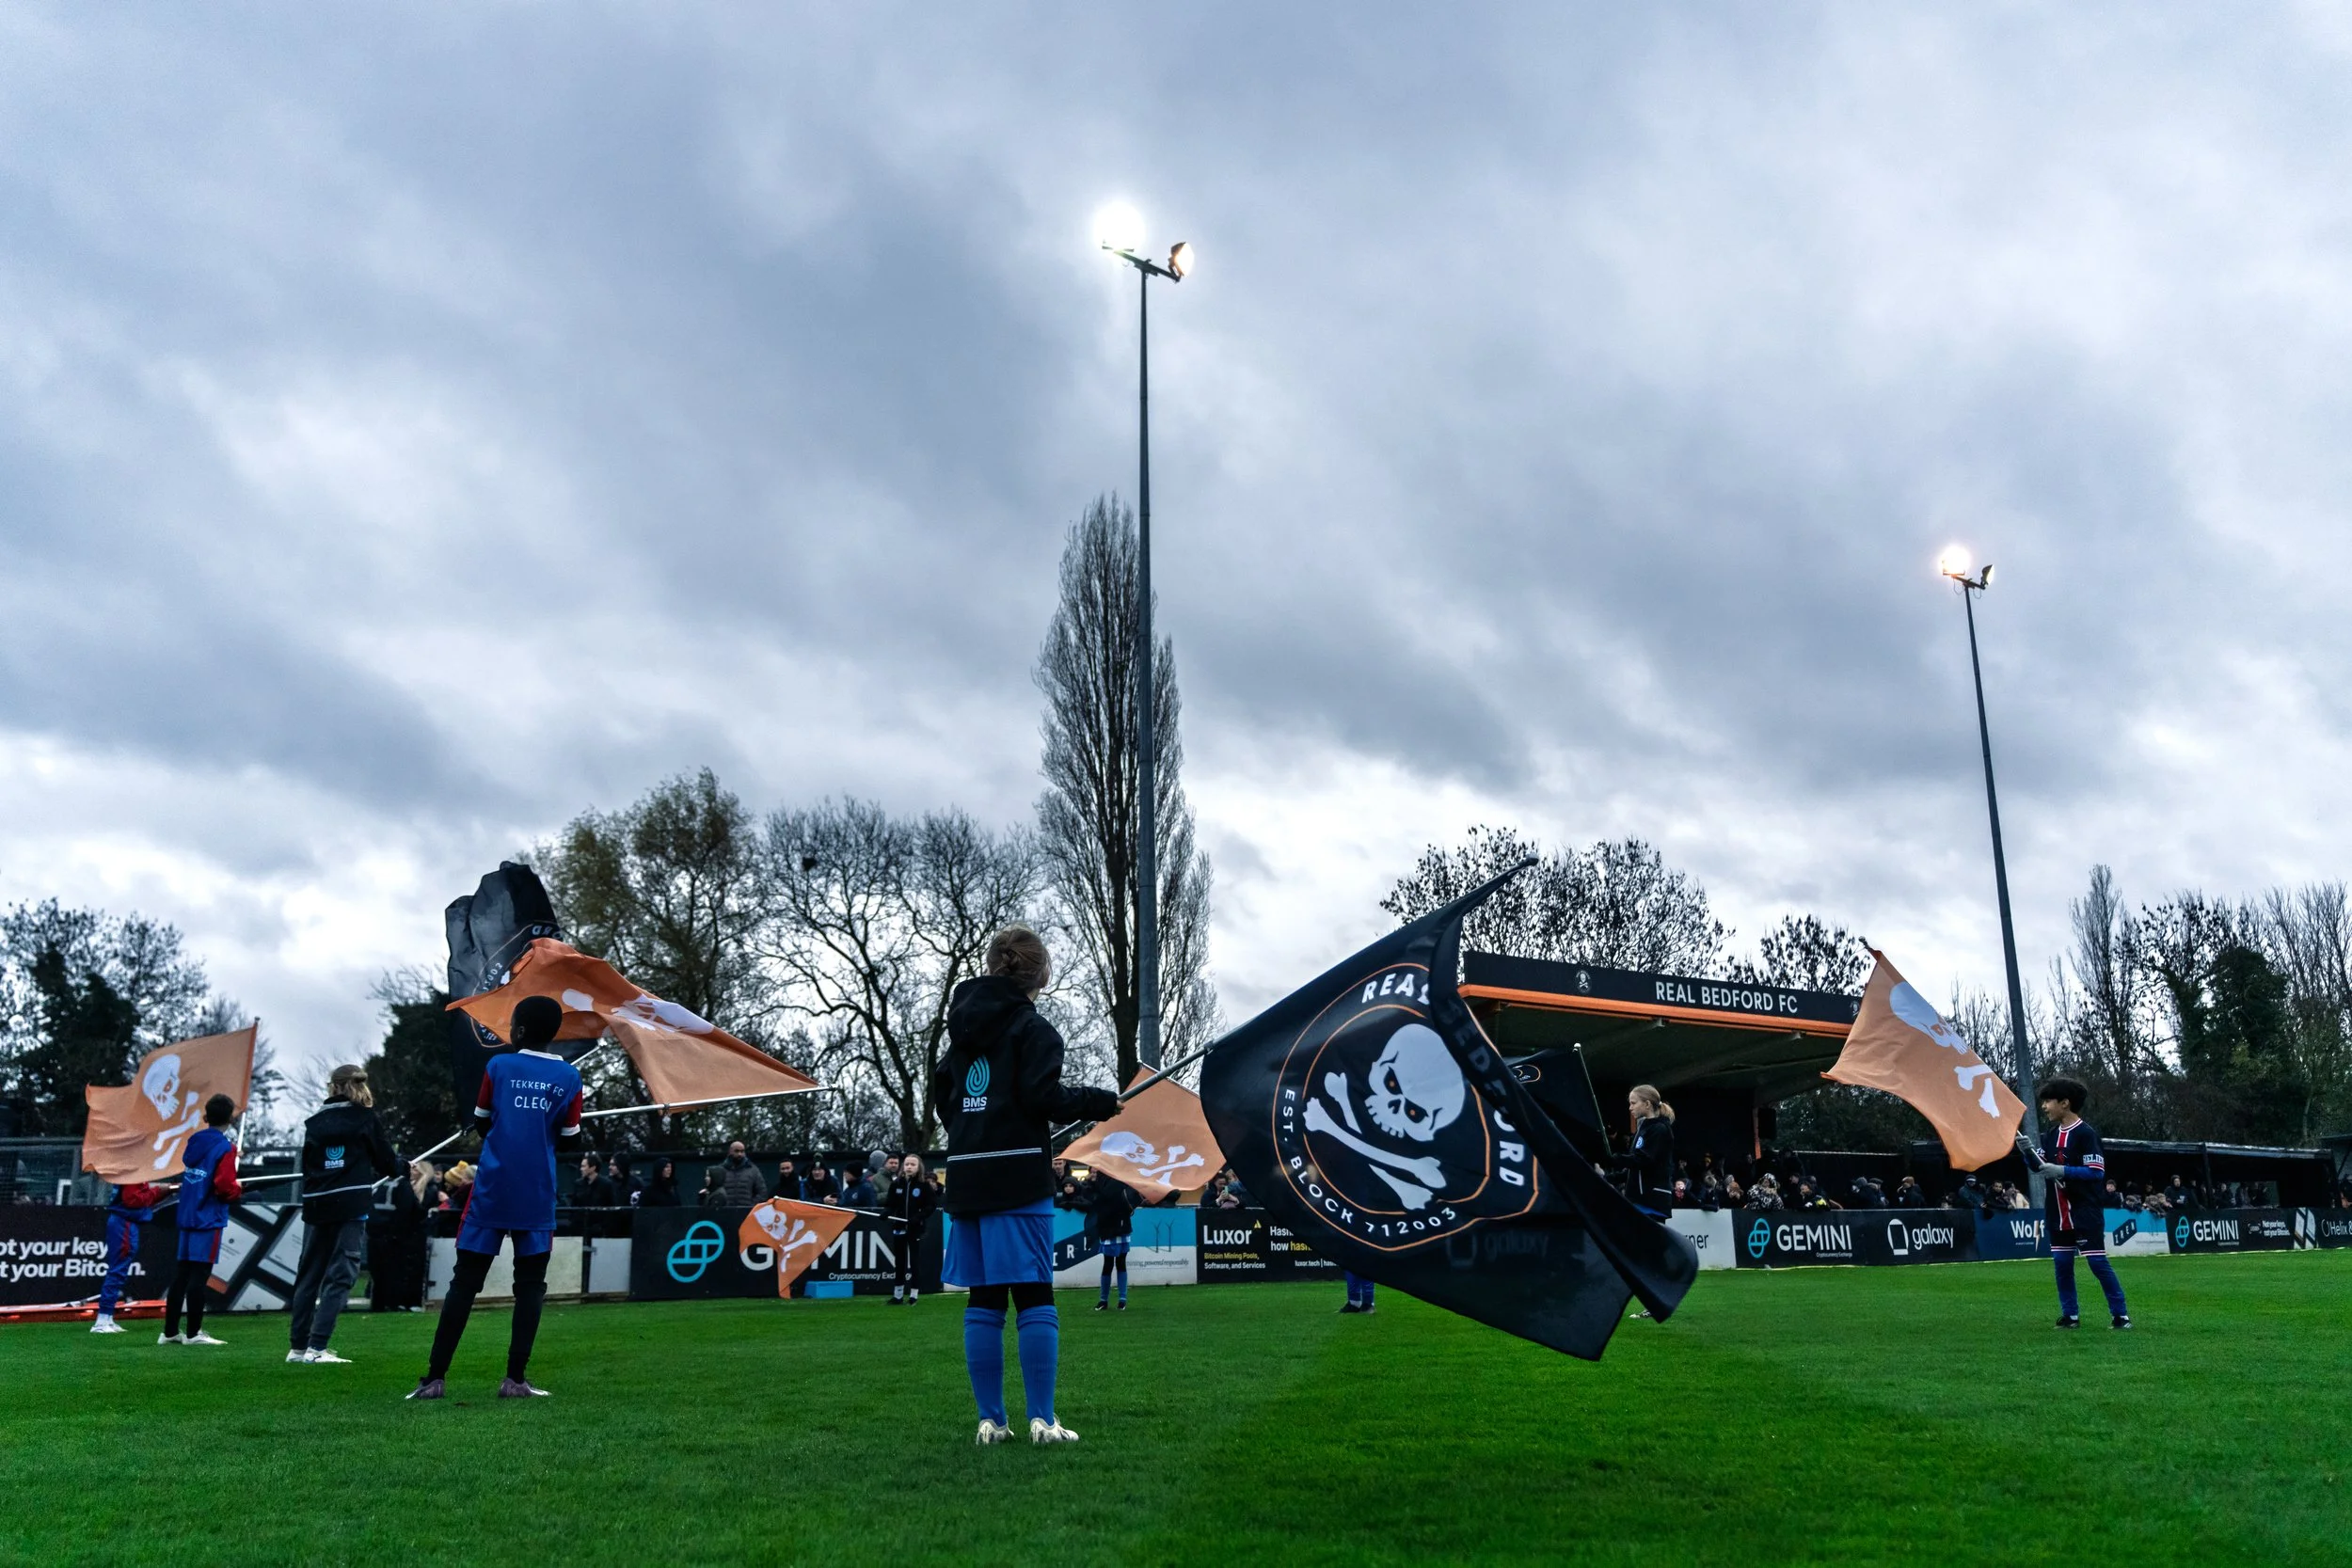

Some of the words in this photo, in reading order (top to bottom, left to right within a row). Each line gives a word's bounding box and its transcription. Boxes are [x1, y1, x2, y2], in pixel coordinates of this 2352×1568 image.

[1656, 981, 1695, 1004] REAL
[1701, 986, 1773, 1011] BEDFORD
[1778, 994, 1798, 1014] FC
[510, 1079, 552, 1091] TEKKERS
[552, 1085, 564, 1097] FC
[962, 1097, 988, 1108] BMS
[1282, 1088, 1295, 1142] EST.
[1290, 1155, 1355, 1223] BLOCK
[1365, 1207, 1455, 1237] 712003
[1203, 1225, 1252, 1245] Luxor
[1776, 1225, 1852, 1251] GEMINI
[1912, 1223, 1953, 1251] galaxy
[2193, 1220, 2239, 1242] GEMINI
[2329, 1220, 2347, 1235] Helix
[19, 1242, 70, 1260] your
[72, 1237, 108, 1259] key
[740, 1230, 911, 1271] GMIN
[1223, 1252, 1242, 1260] Mining
[1242, 1252, 1260, 1260] Pools,
[1270, 1241, 1289, 1251] how
[9, 1263, 62, 1283] your
[64, 1259, 146, 1277] Bitcn.
[829, 1272, 881, 1280] Cryptocurrency
